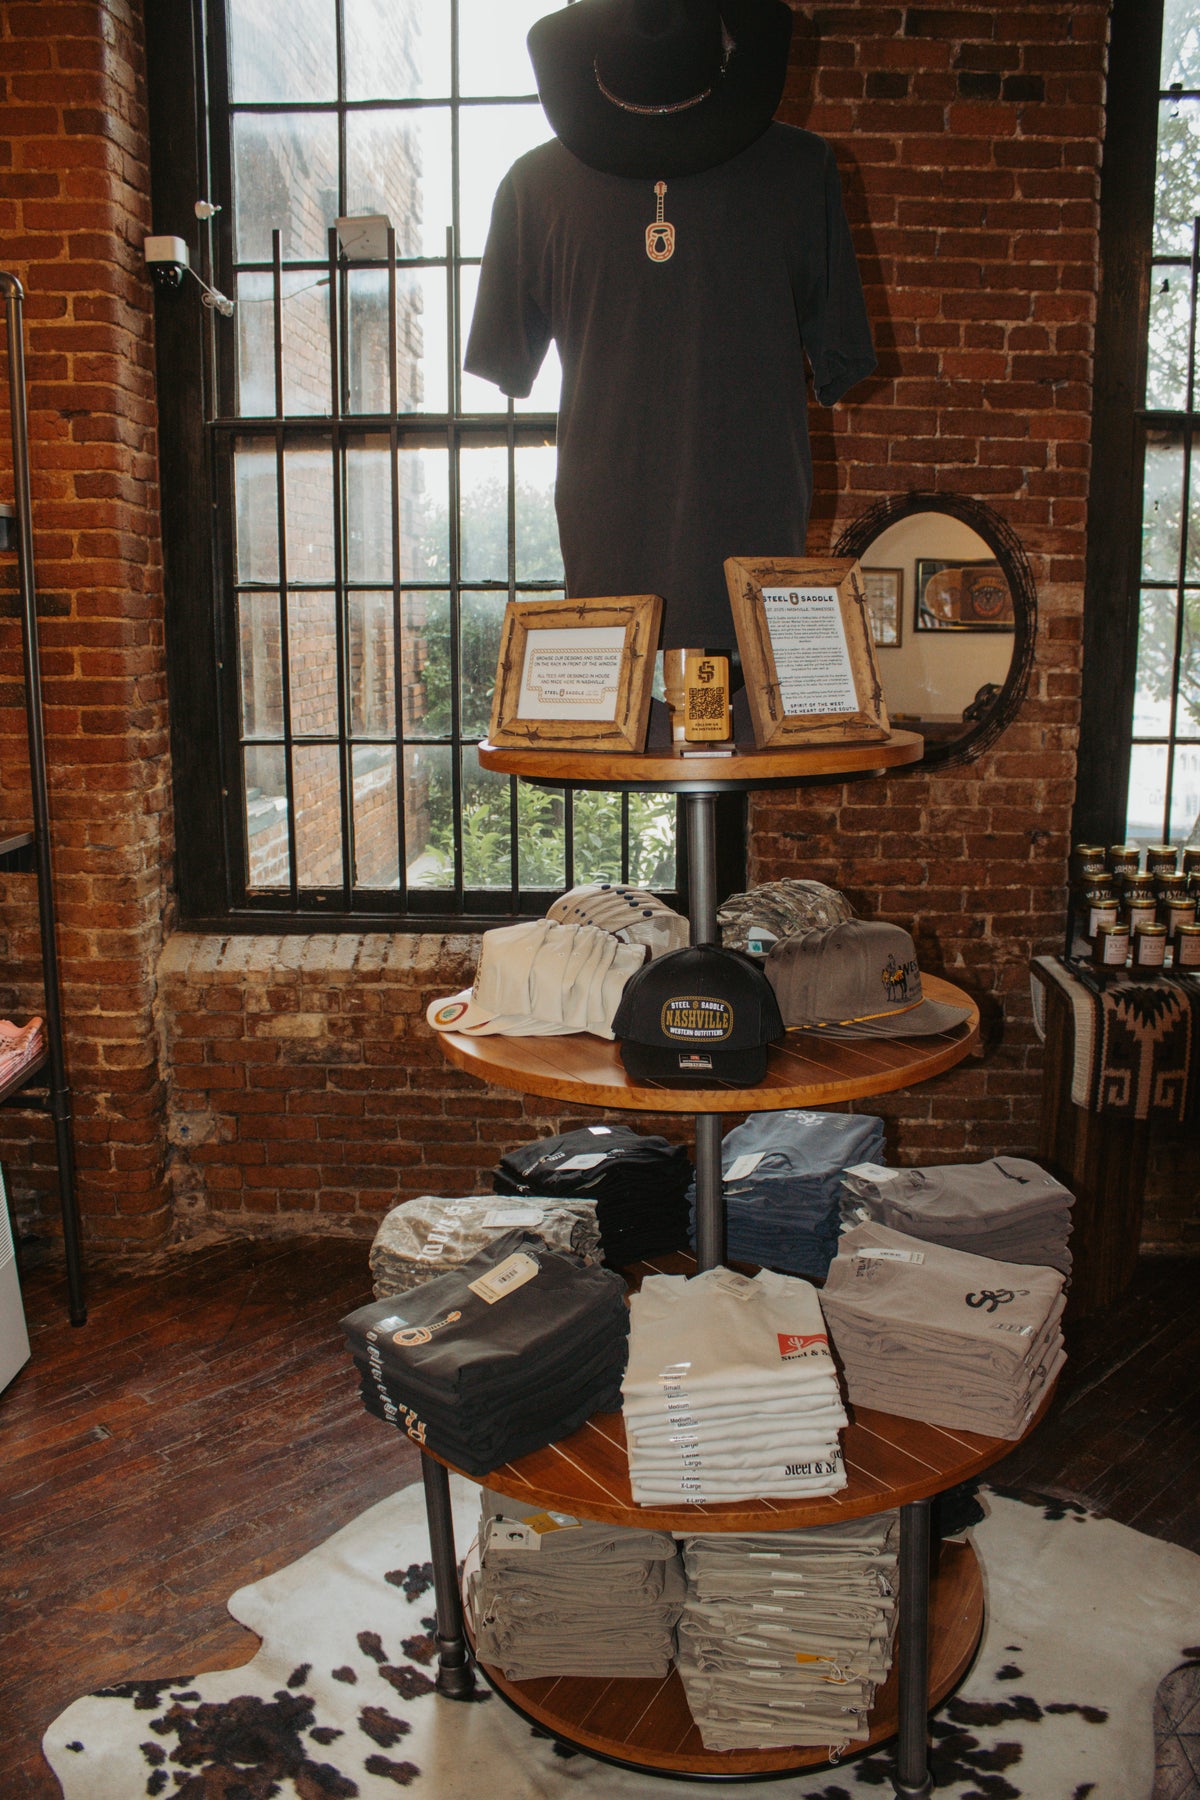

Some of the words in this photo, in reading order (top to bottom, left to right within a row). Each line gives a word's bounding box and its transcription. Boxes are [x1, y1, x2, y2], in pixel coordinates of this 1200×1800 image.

[671, 1001, 690, 1009] STEEL
[701, 1001, 724, 1012] SADDLE
[666, 1009, 728, 1028] NASHVILLE
[670, 1027, 694, 1036] WESTERN
[781, 1352, 807, 1361] Steel
[785, 1462, 811, 1476] Steel
[815, 1462, 823, 1474] &
